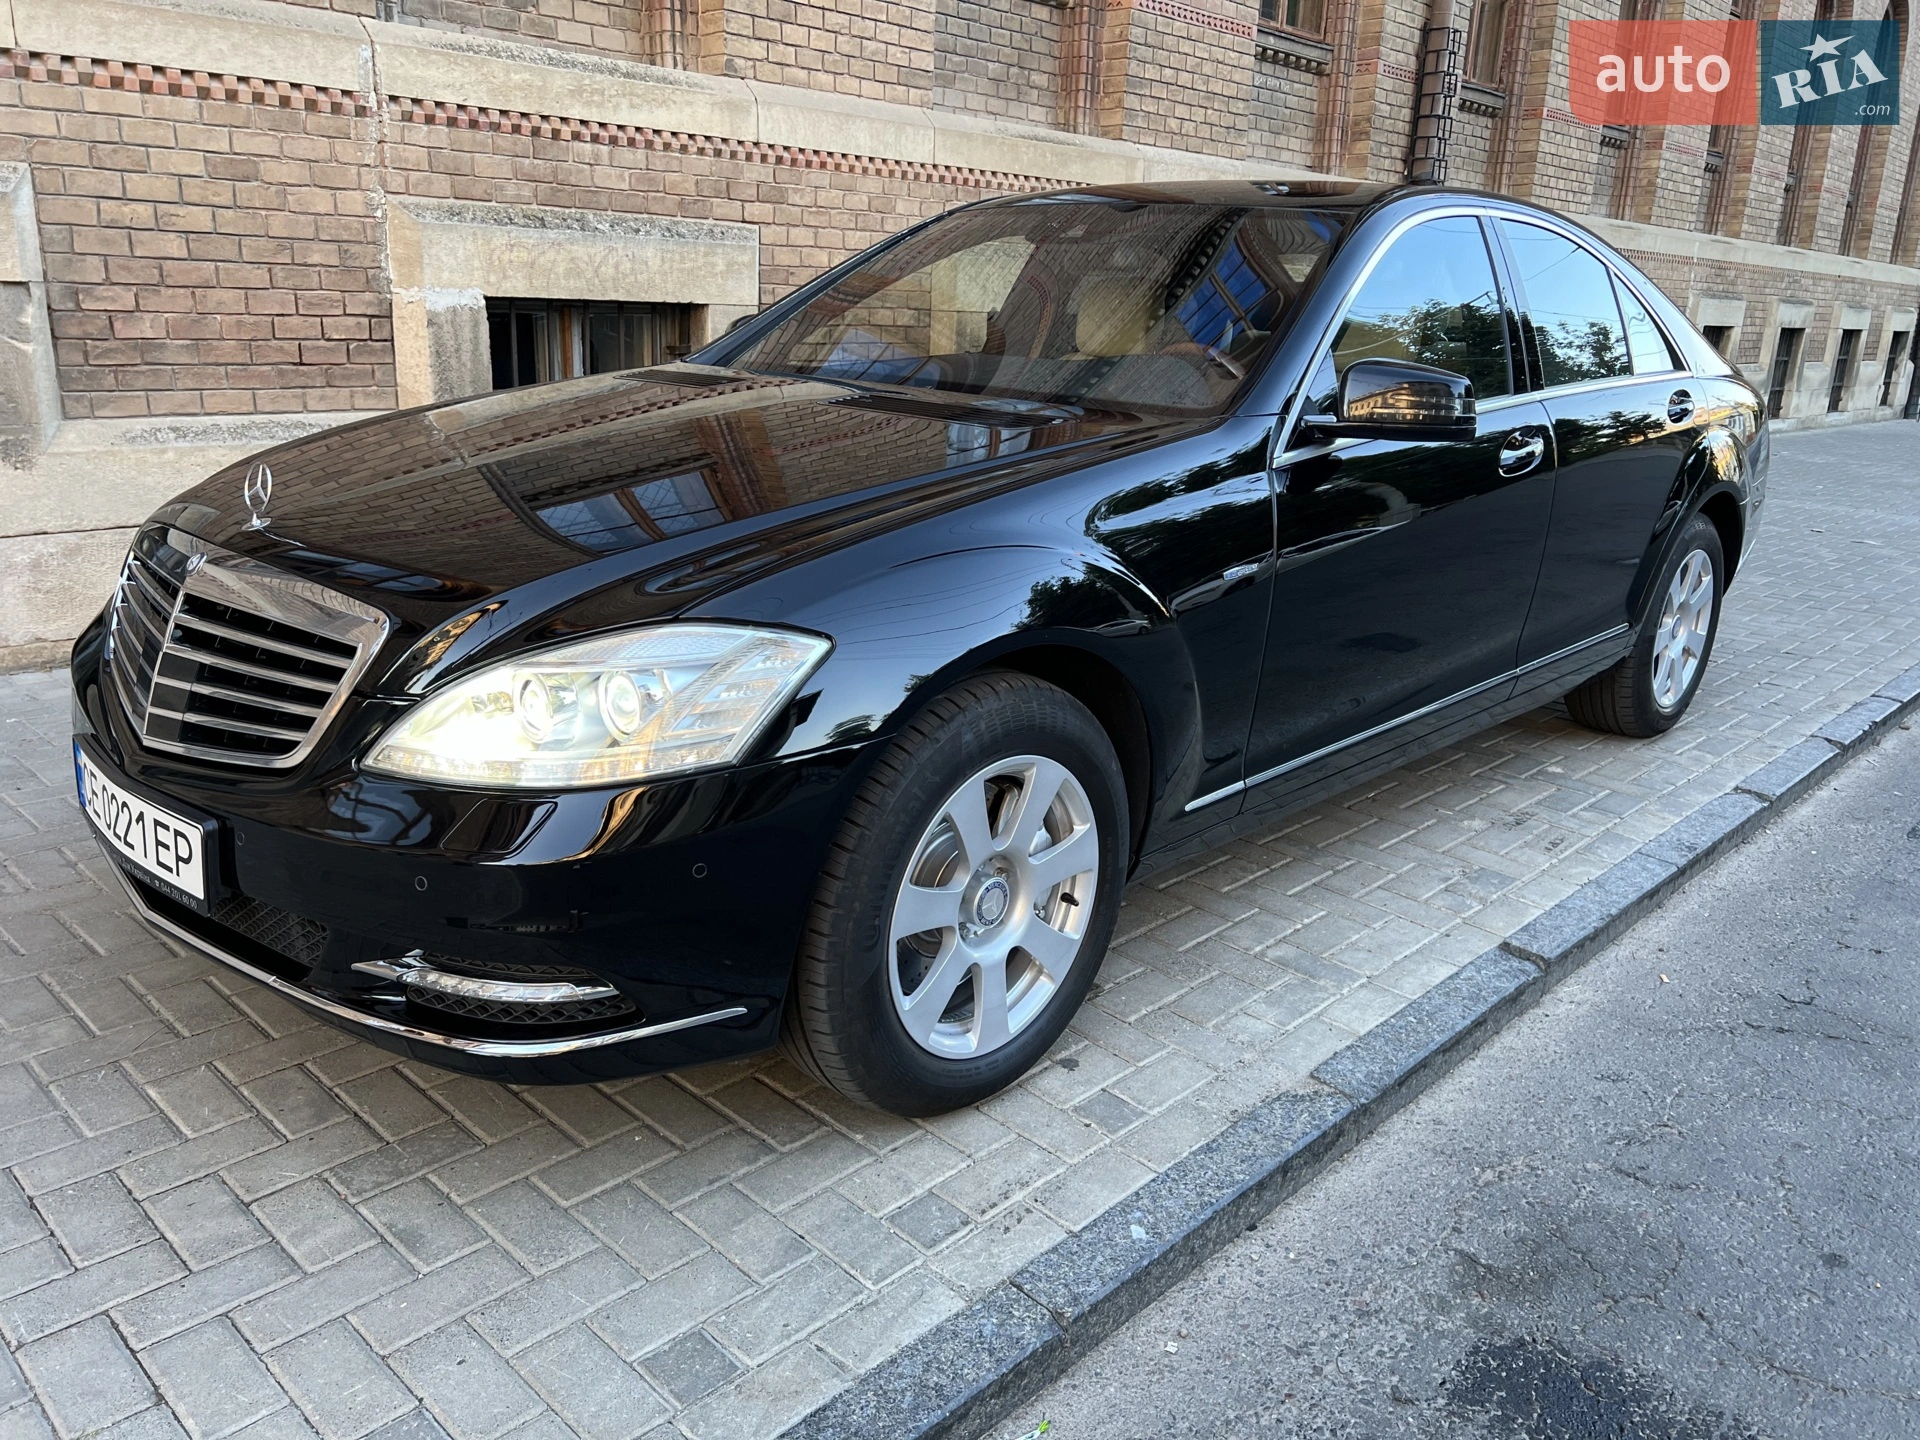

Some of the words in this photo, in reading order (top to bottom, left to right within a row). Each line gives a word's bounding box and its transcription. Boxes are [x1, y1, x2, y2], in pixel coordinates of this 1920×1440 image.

[83, 762, 102, 821] CE
[101, 783, 148, 860] 0221
[153, 817, 193, 878] EP
